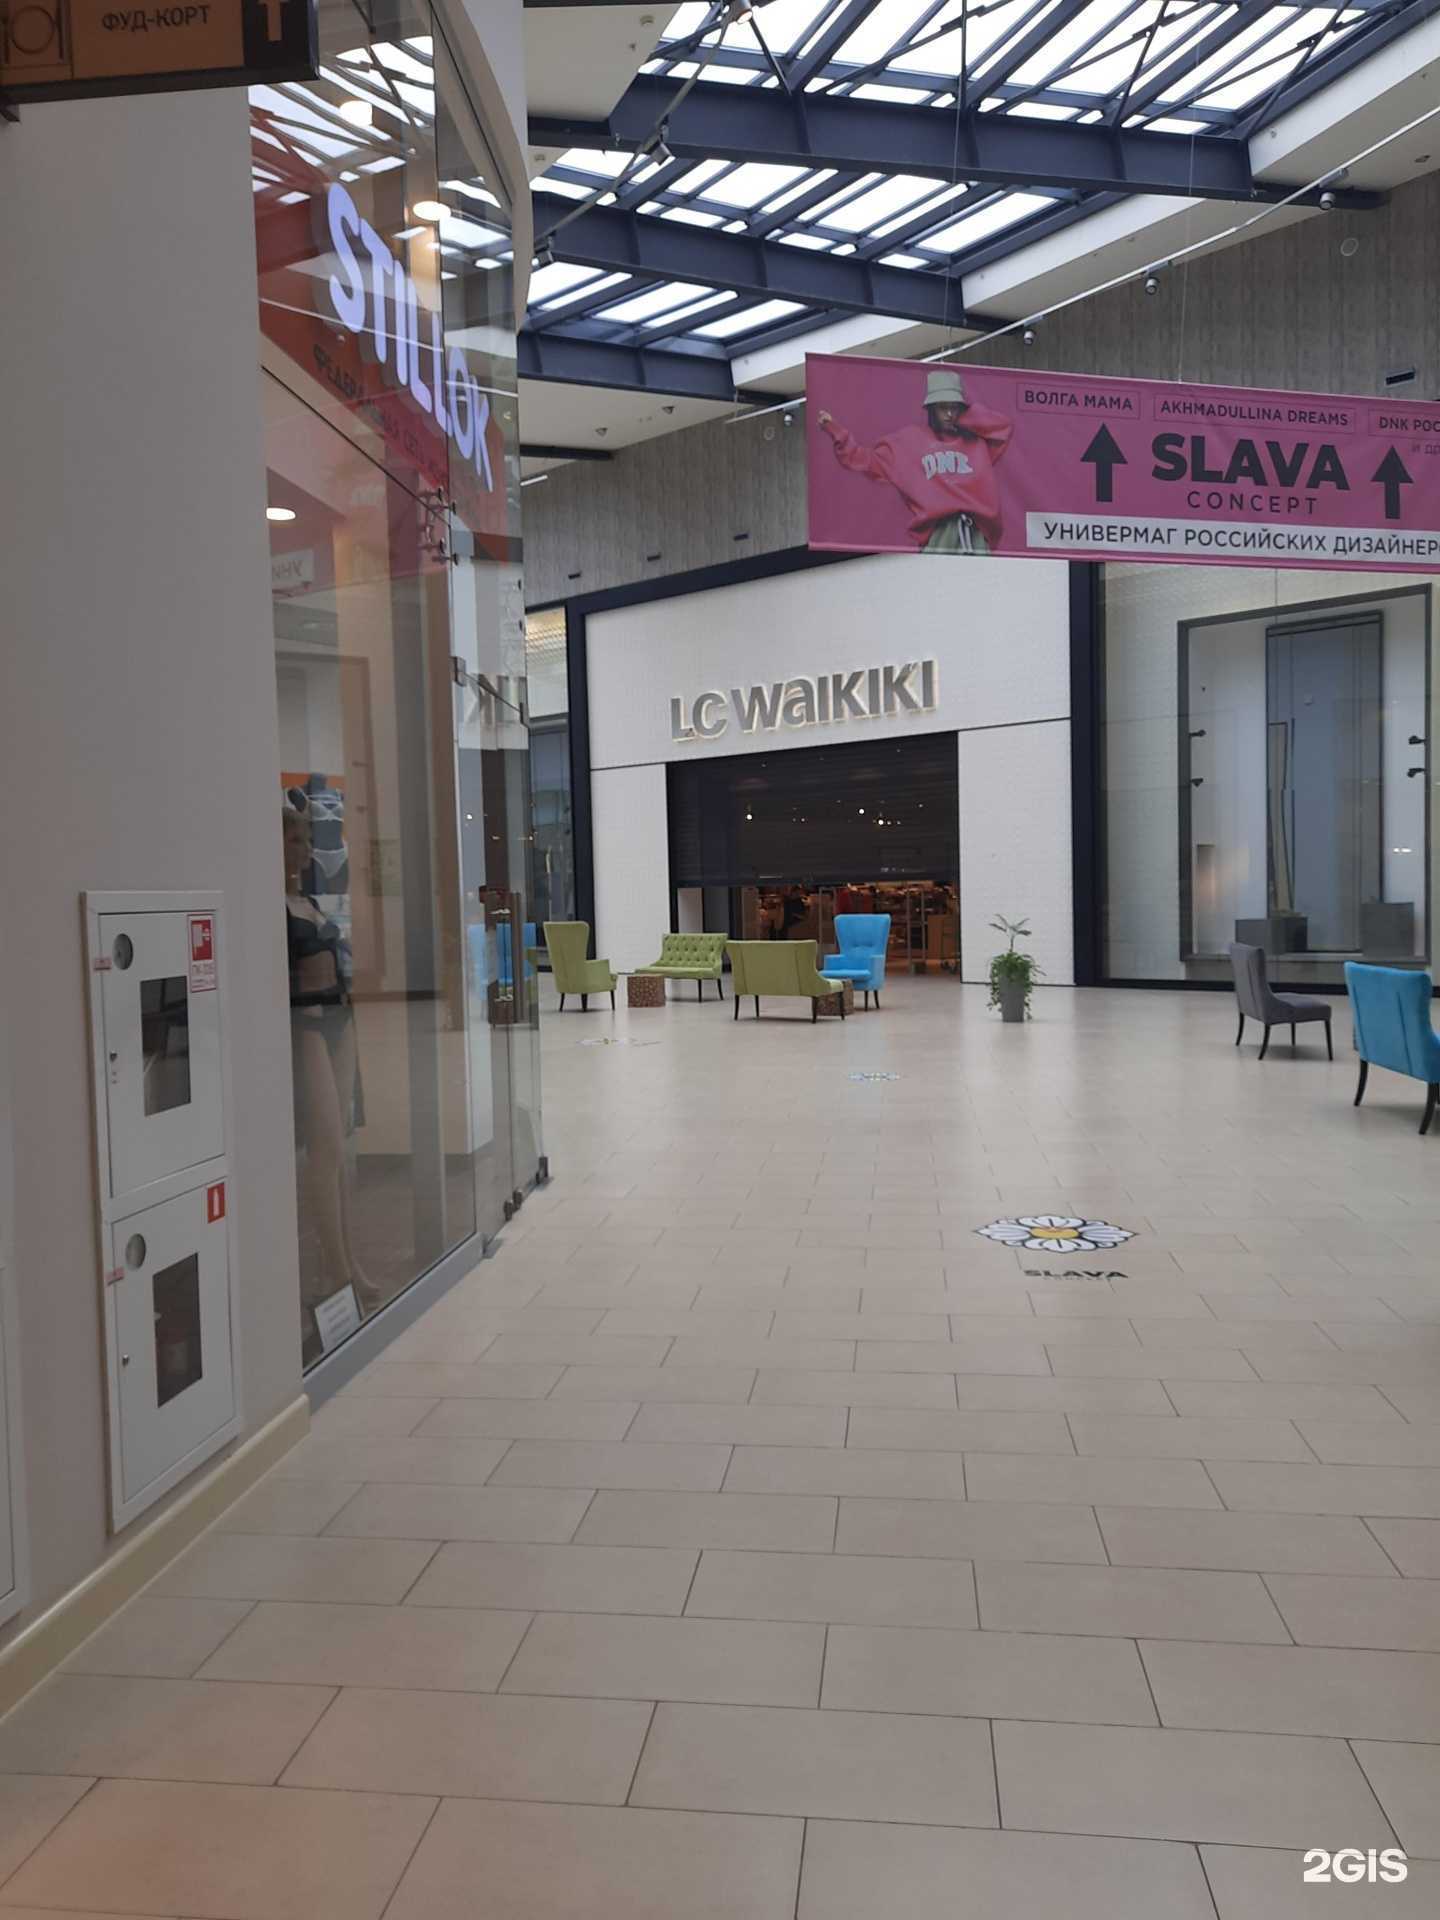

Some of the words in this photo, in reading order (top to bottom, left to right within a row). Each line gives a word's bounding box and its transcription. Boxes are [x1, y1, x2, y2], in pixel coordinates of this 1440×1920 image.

[102, 5, 211, 33] ФУД-КОРТ
[327, 182, 494, 493] STILLOK
[1024, 390, 1079, 407] ВОЛГА
[1084, 394, 1133, 411] МАМА
[1160, 400, 1283, 422] AKHMADULLINA
[1287, 409, 1348, 427] DREAMS
[1378, 416, 1409, 431] DNK
[1151, 432, 1350, 491] SLAVA
[1187, 490, 1318, 515] CONCEPT
[1043, 521, 1178, 546] УНИВЕРМАГ
[1184, 528, 1327, 552] РОССИЙСКИХ
[1332, 534, 1440, 556] ДИЗАЙНЕР
[669, 691, 729, 742] LC
[1022, 1269, 1129, 1280] SLAVA
